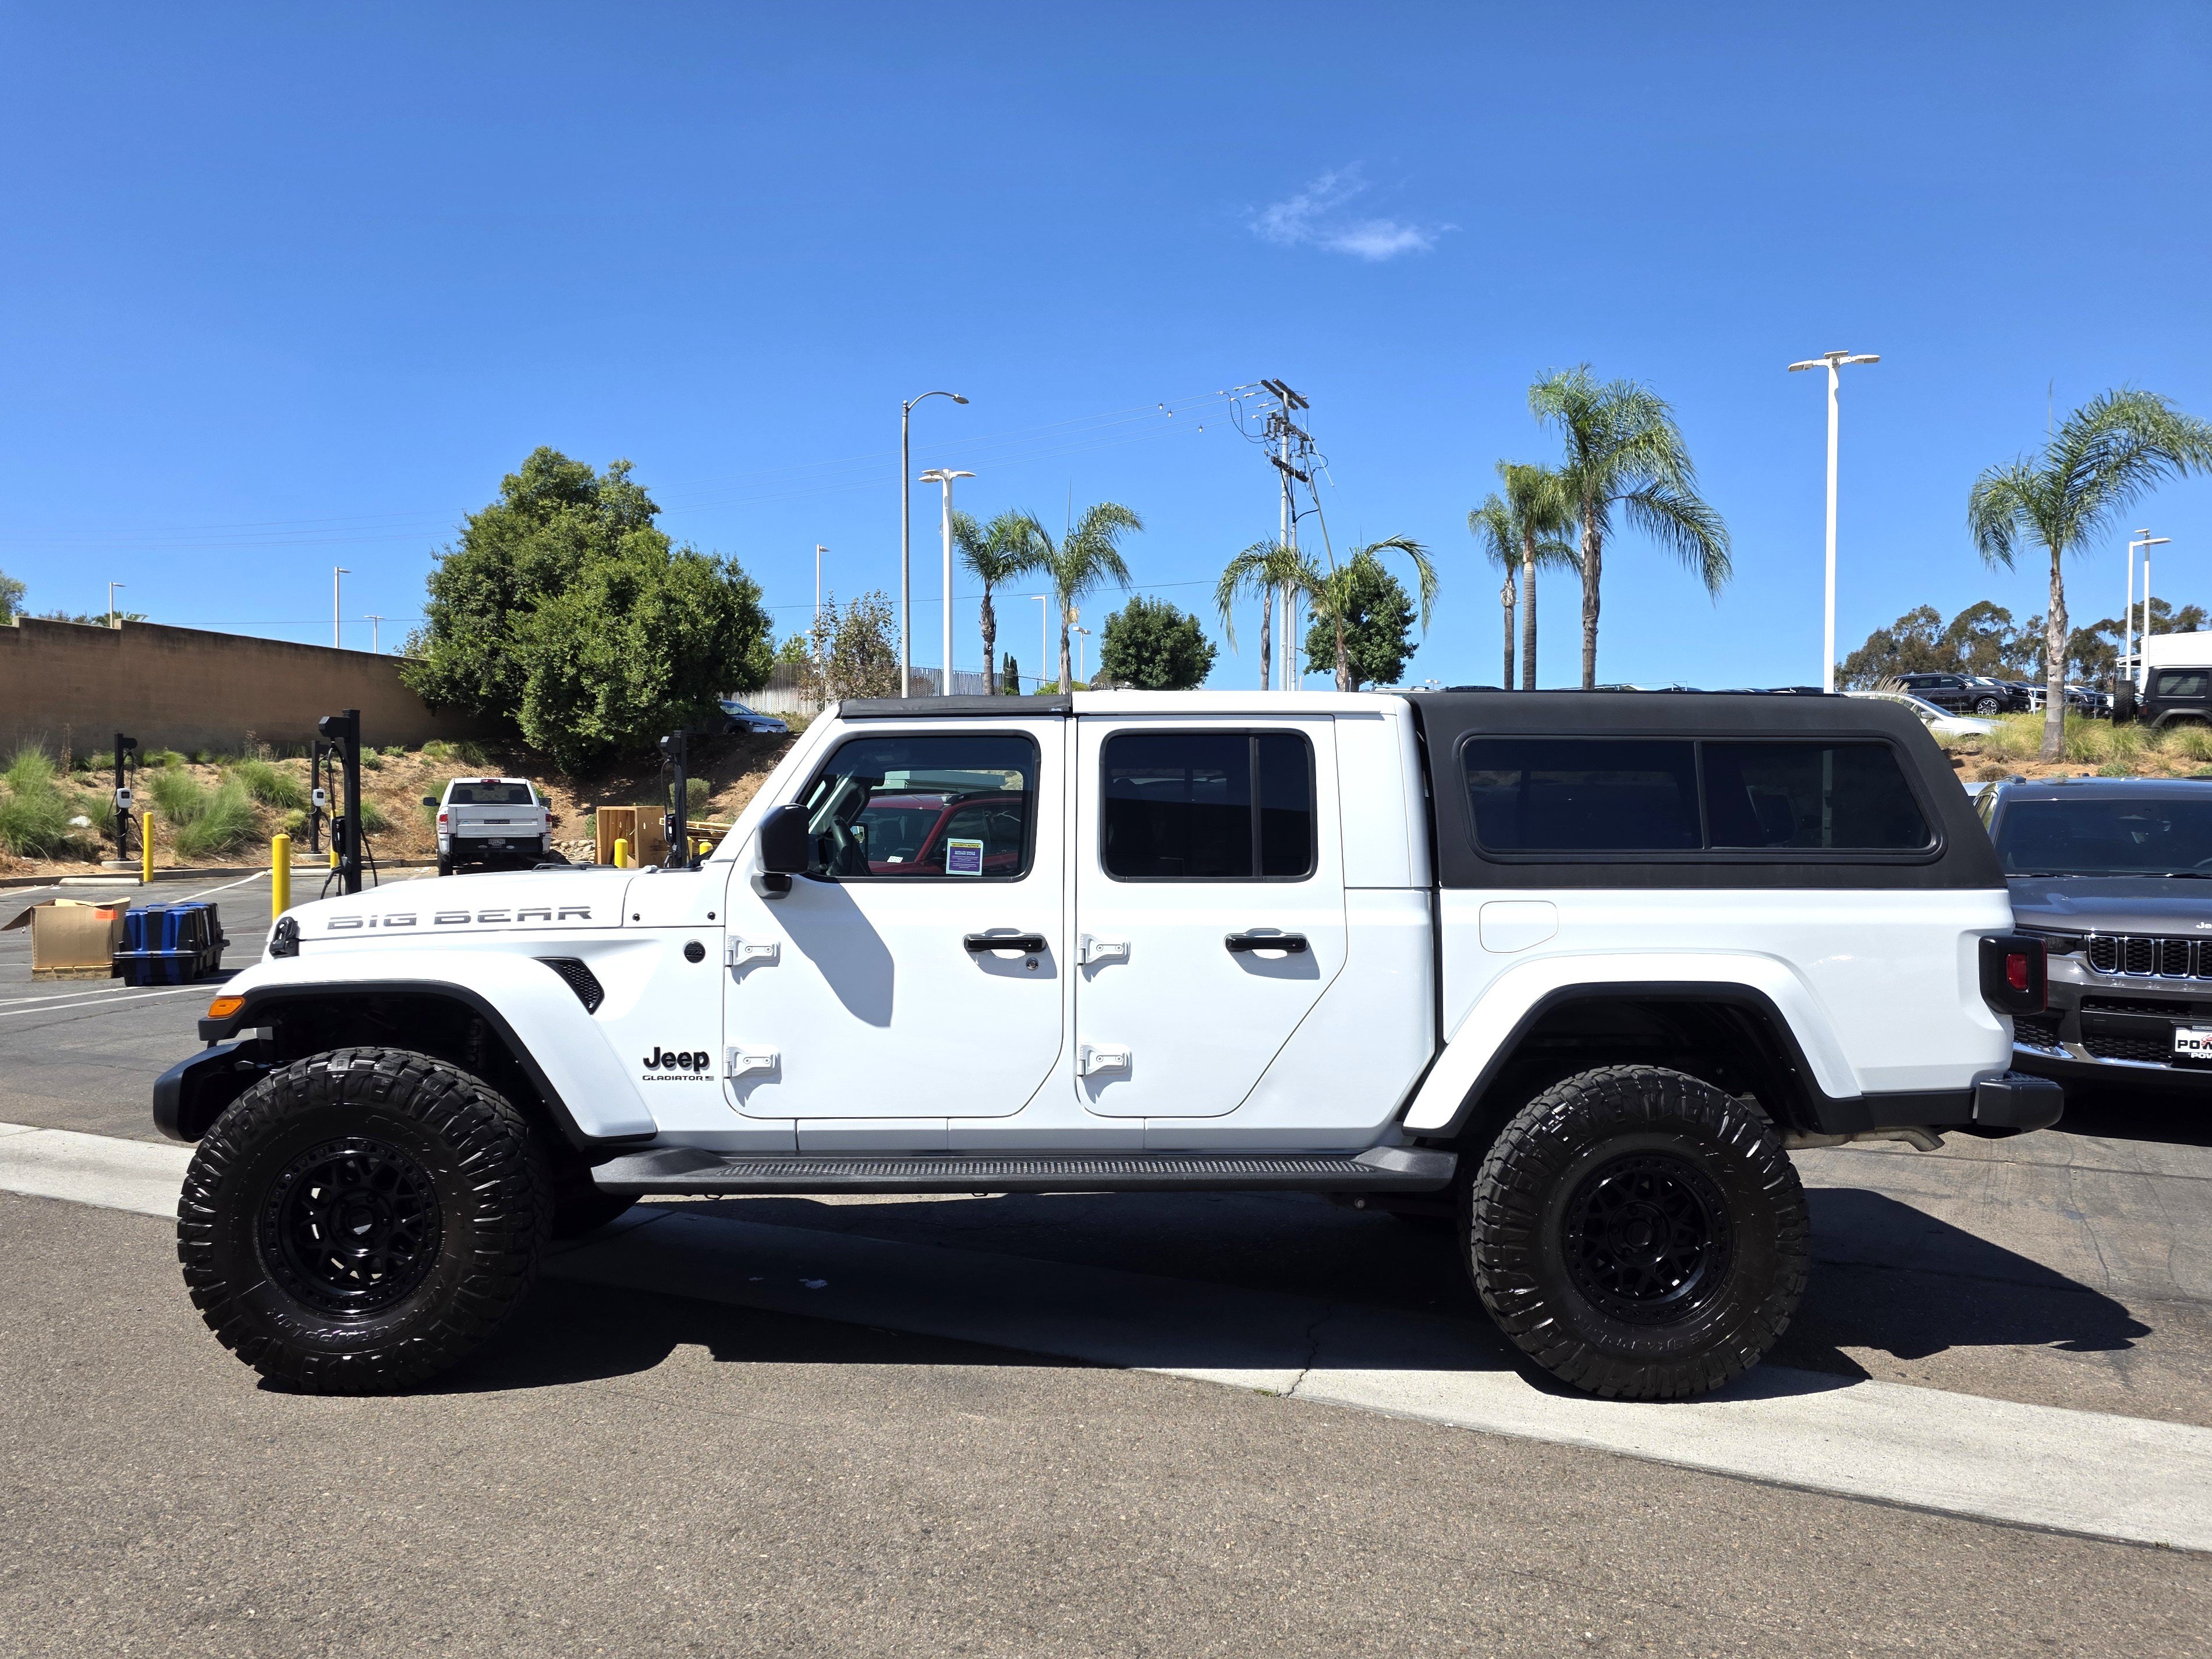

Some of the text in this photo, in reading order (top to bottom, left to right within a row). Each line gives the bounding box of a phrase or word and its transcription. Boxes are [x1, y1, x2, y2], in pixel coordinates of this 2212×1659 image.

[327, 906, 593, 930] BIG BEAR
[643, 1046, 710, 1072] Jeep
